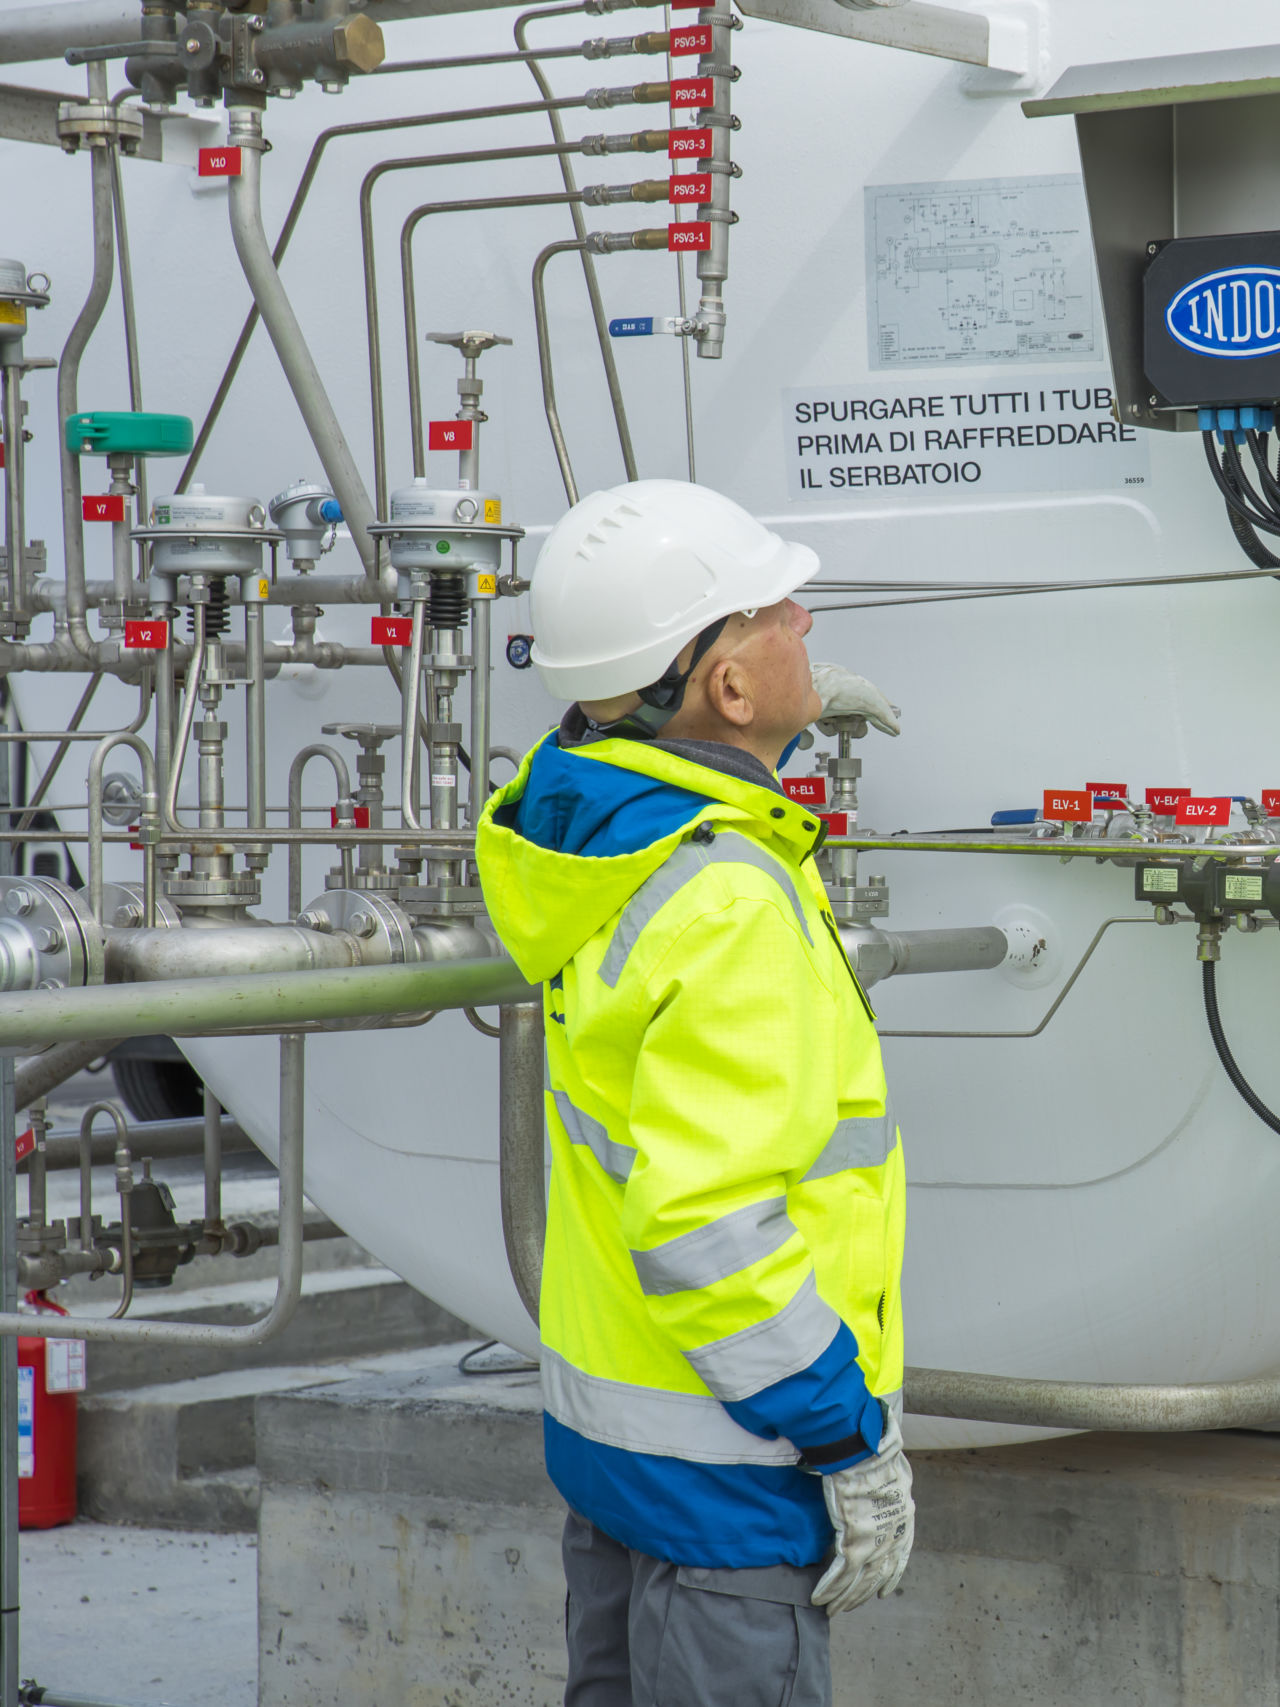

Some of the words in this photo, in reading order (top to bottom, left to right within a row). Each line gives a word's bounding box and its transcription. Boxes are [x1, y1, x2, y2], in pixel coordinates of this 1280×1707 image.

[674, 35, 707, 48] PSV3-5
[675, 88, 707, 101] PSV3-4
[673, 138, 706, 151] PSV3-3
[210, 156, 227, 168] V10
[674, 183, 706, 196] PSV3-2
[673, 232, 705, 243] PSV3-1
[795, 397, 945, 424] SPURGARE
[950, 391, 1030, 417] TUTTI
[1039, 391, 1046, 412] I
[1052, 388, 1114, 411] TUB
[443, 431, 455, 442] V8
[797, 433, 883, 456] PRIMA
[890, 430, 915, 453] DI
[924, 421, 1137, 452] RAFFREDDARE
[799, 468, 823, 489] IL
[829, 461, 982, 488] SERBATOIO
[1124, 476, 1145, 485] 36559
[96, 504, 107, 515] V7
[140, 630, 151, 642] V2
[386, 626, 397, 638] V1
[790, 785, 815, 795] R-EL1
[1052, 799, 1081, 811] ELV-1
[1185, 804, 1217, 816] ELV-2
